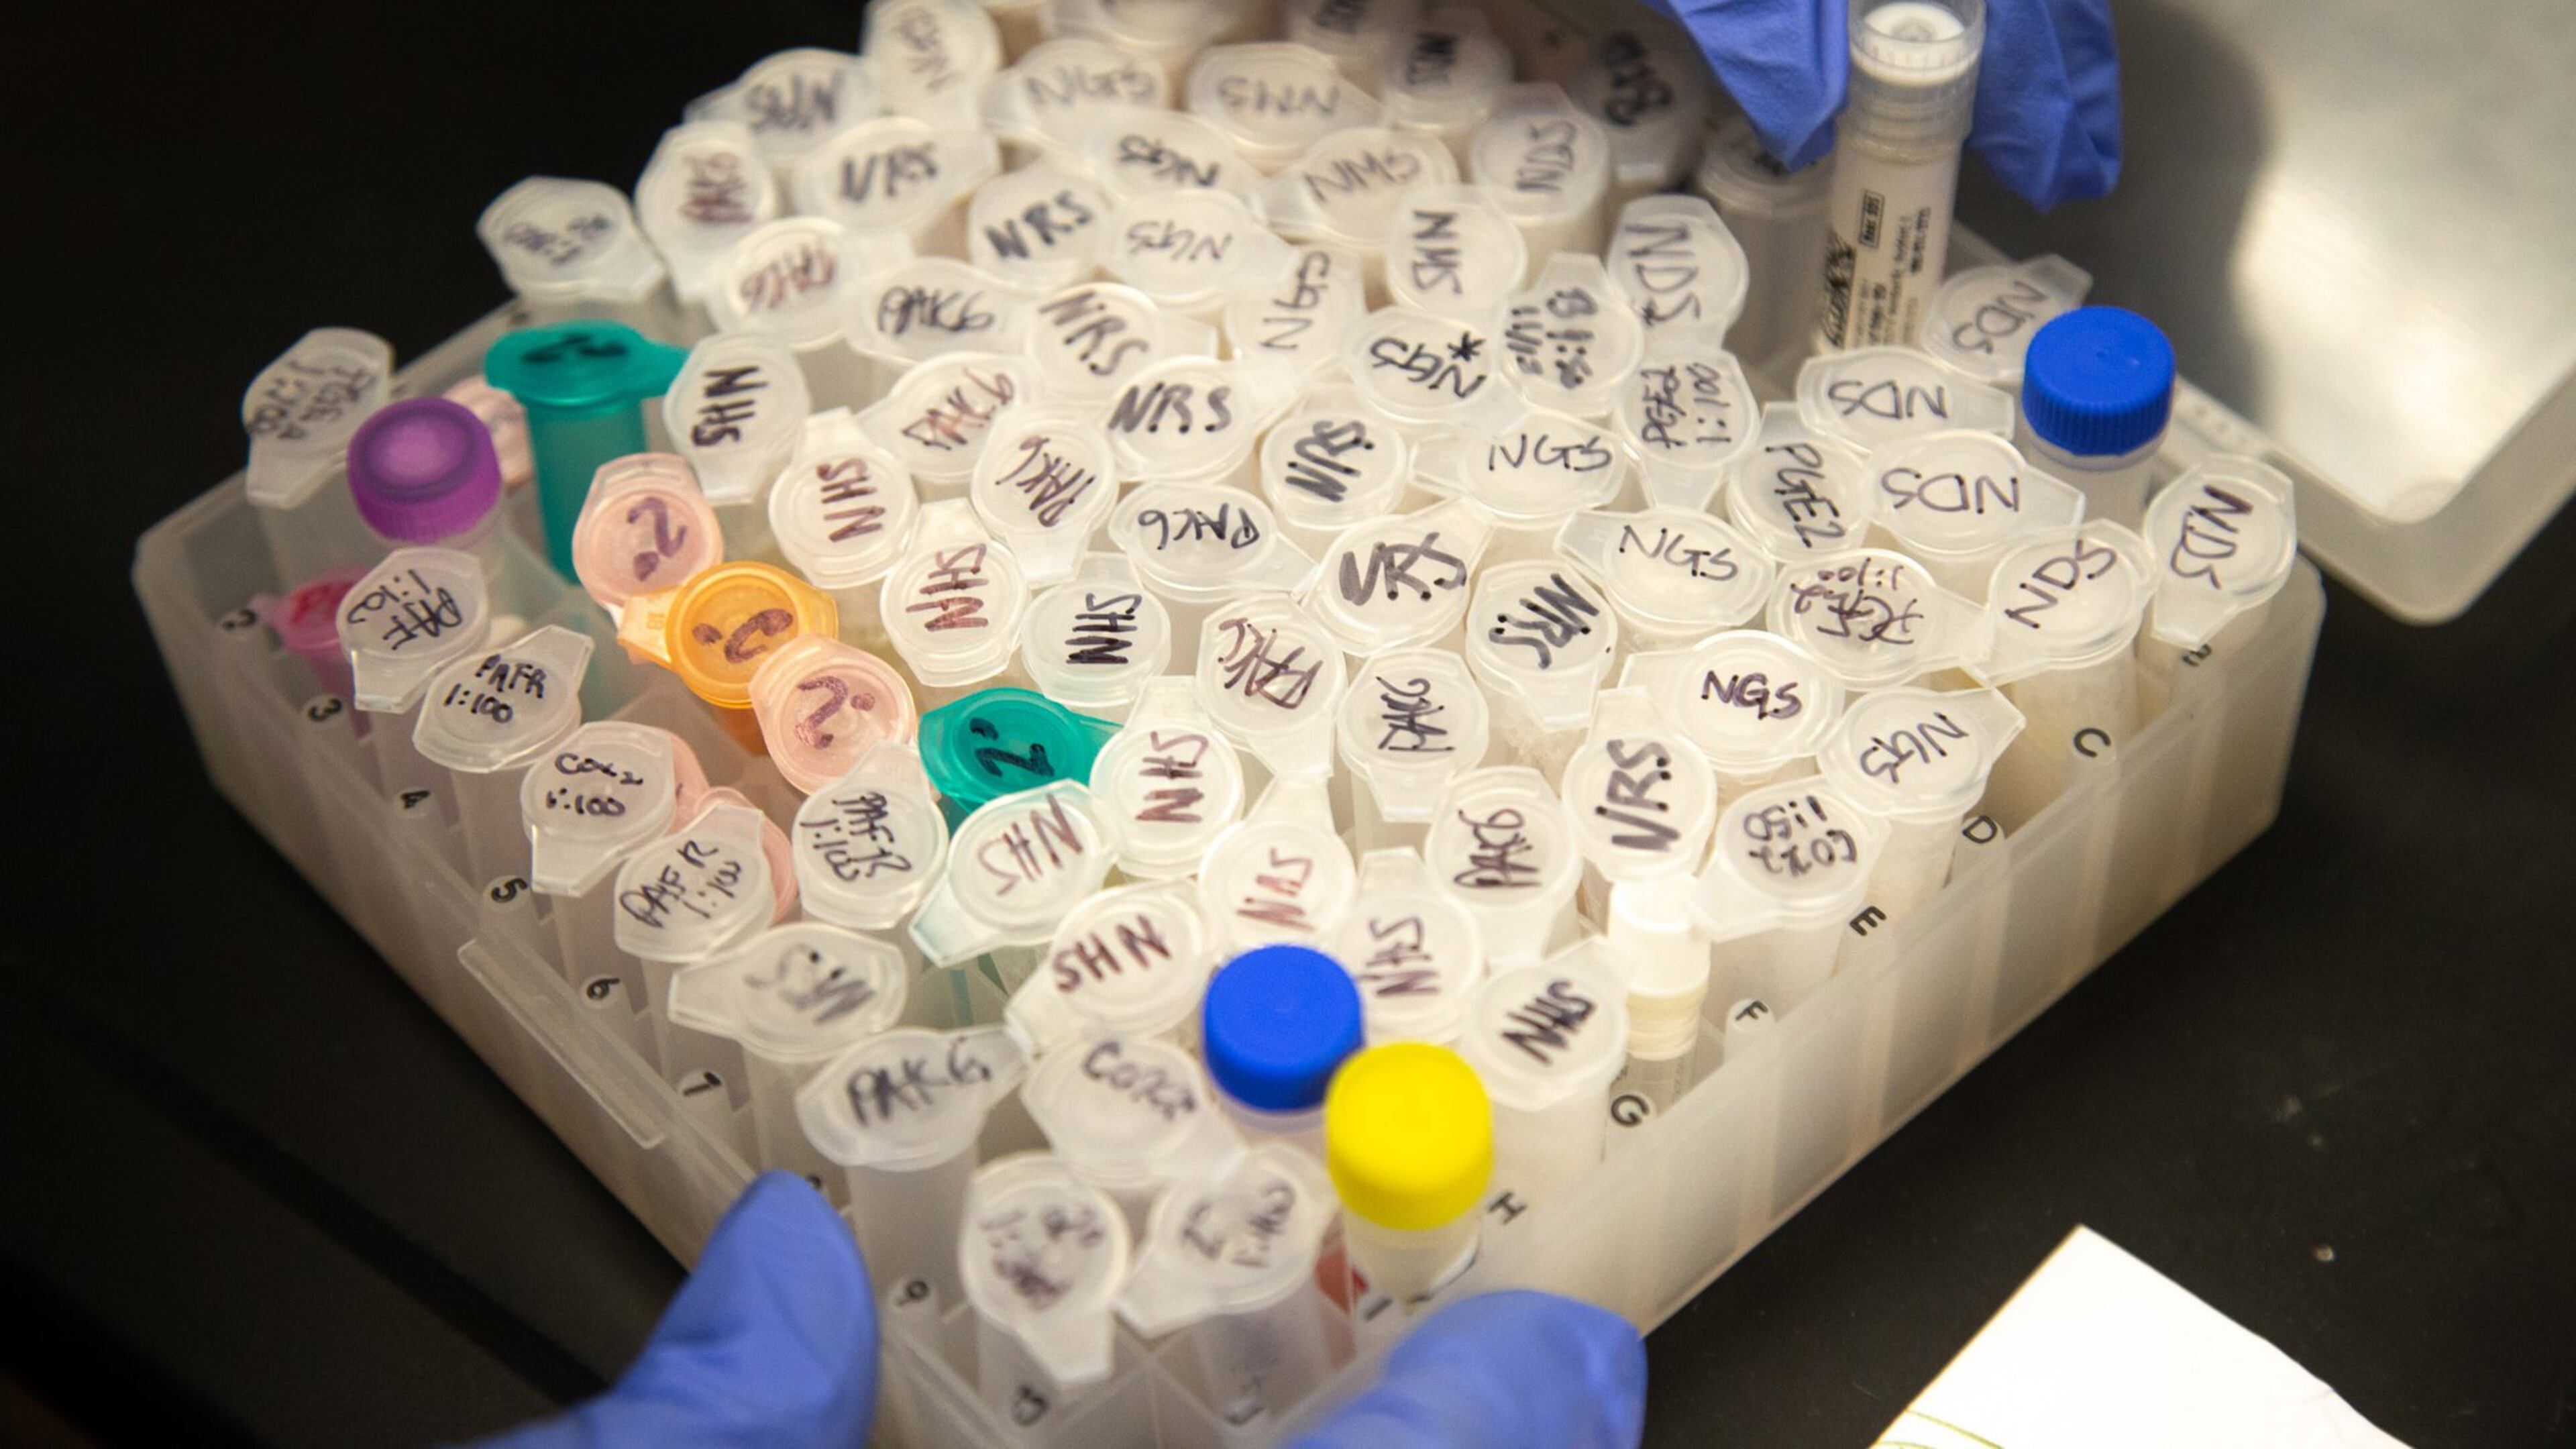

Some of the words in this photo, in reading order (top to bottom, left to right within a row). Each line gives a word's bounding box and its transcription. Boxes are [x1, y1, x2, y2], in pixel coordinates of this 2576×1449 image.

[1118, 133, 1220, 188] NGS
[1302, 148, 1423, 201] NMS
[983, 190, 1093, 260] NRS
[1125, 219, 1234, 262] NGS
[876, 285, 995, 335] PAK6
[1038, 290, 1150, 377] NRS
[1951, 279, 2046, 356] NDS
[690, 365, 770, 448] NHS
[1108, 380, 1233, 435] NRS
[1686, 362, 1733, 445] 1:100
[1827, 380, 1949, 422] NDS
[1284, 419, 1375, 503] NRS
[1487, 433, 1615, 472] NGS
[815, 457, 887, 543] NHS
[1764, 441, 1847, 550] PGE2
[1879, 466, 2021, 516] NDS
[1137, 502, 1261, 551] PAK6
[1619, 524, 1739, 582] NGS
[2169, 483, 2255, 590] NDS
[905, 543, 990, 633] NHS
[1338, 532, 1468, 606] NRS
[1817, 556, 1905, 591] 1:100
[2003, 538, 2118, 631] NDS
[382, 586, 464, 652] PAF
[1064, 592, 1143, 665] NHS
[1488, 572, 1601, 670] NRS
[474, 653, 549, 699] PAFR
[1218, 617, 1325, 710] PAK6
[307, 698, 342, 723] 3
[442, 681, 515, 724] 1:100
[1701, 669, 1804, 721] NGS
[1857, 710, 1970, 784] NGS
[2072, 727, 2112, 759] C
[400, 789, 431, 809] 4
[543, 787, 627, 818] 1:100
[1135, 731, 1211, 824] NHS
[1594, 738, 1682, 852] NRS
[977, 793, 1084, 898] NHS
[1742, 794, 1829, 843] 1:50
[1962, 814, 1999, 845] D
[1452, 808, 1543, 891] PAK6
[490, 877, 529, 904] 5
[1849, 905, 1887, 936] E
[586, 977, 621, 1002] 6
[1734, 1000, 1770, 1021] F
[1500, 979, 1598, 1067] NHS
[682, 1071, 722, 1097] 7
[1609, 1093, 1650, 1128] G
[1487, 1191, 1528, 1224] H
